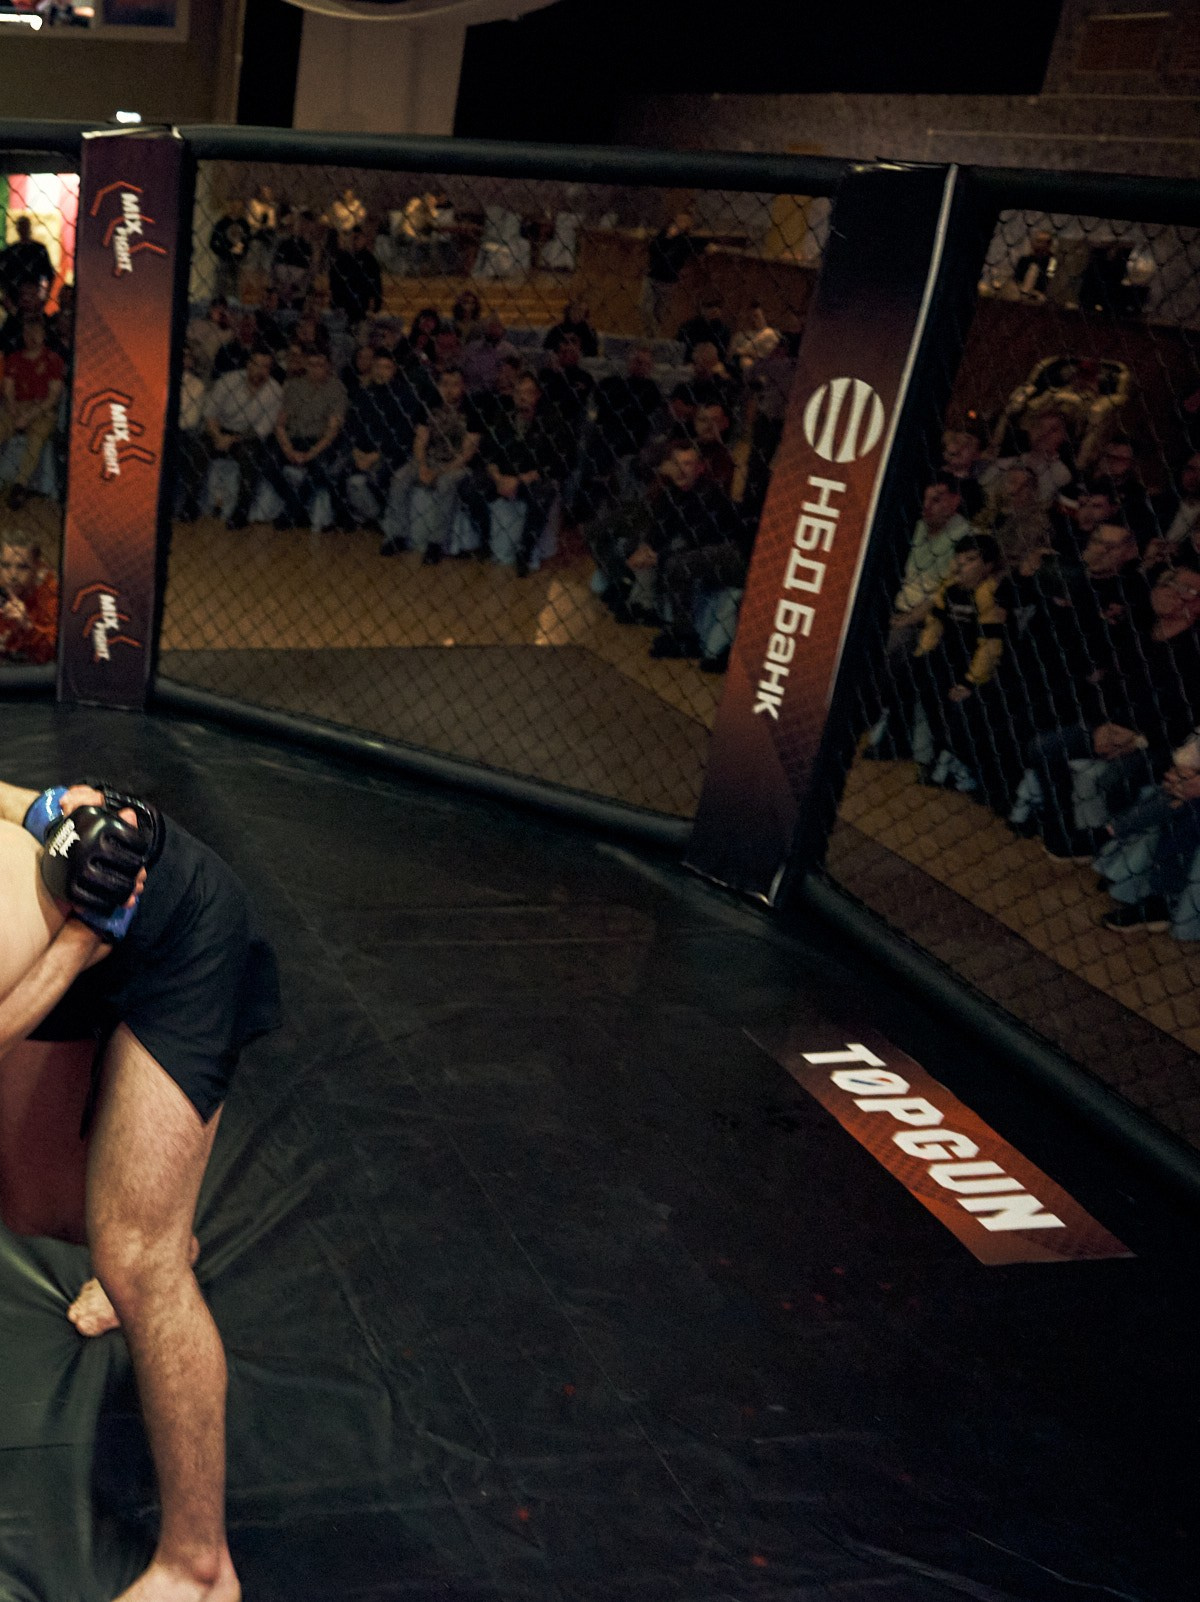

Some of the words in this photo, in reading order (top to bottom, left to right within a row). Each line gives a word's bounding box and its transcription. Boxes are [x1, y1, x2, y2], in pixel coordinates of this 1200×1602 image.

[121, 193, 143, 235] MIX
[114, 227, 133, 272] FIGHT
[109, 403, 130, 442] MIX
[103, 434, 120, 475] FIGHT
[784, 475, 847, 595] НБД
[99, 594, 119, 630] MIX
[753, 599, 816, 720] Банк
[802, 1043, 1066, 1231] TOPGUN
